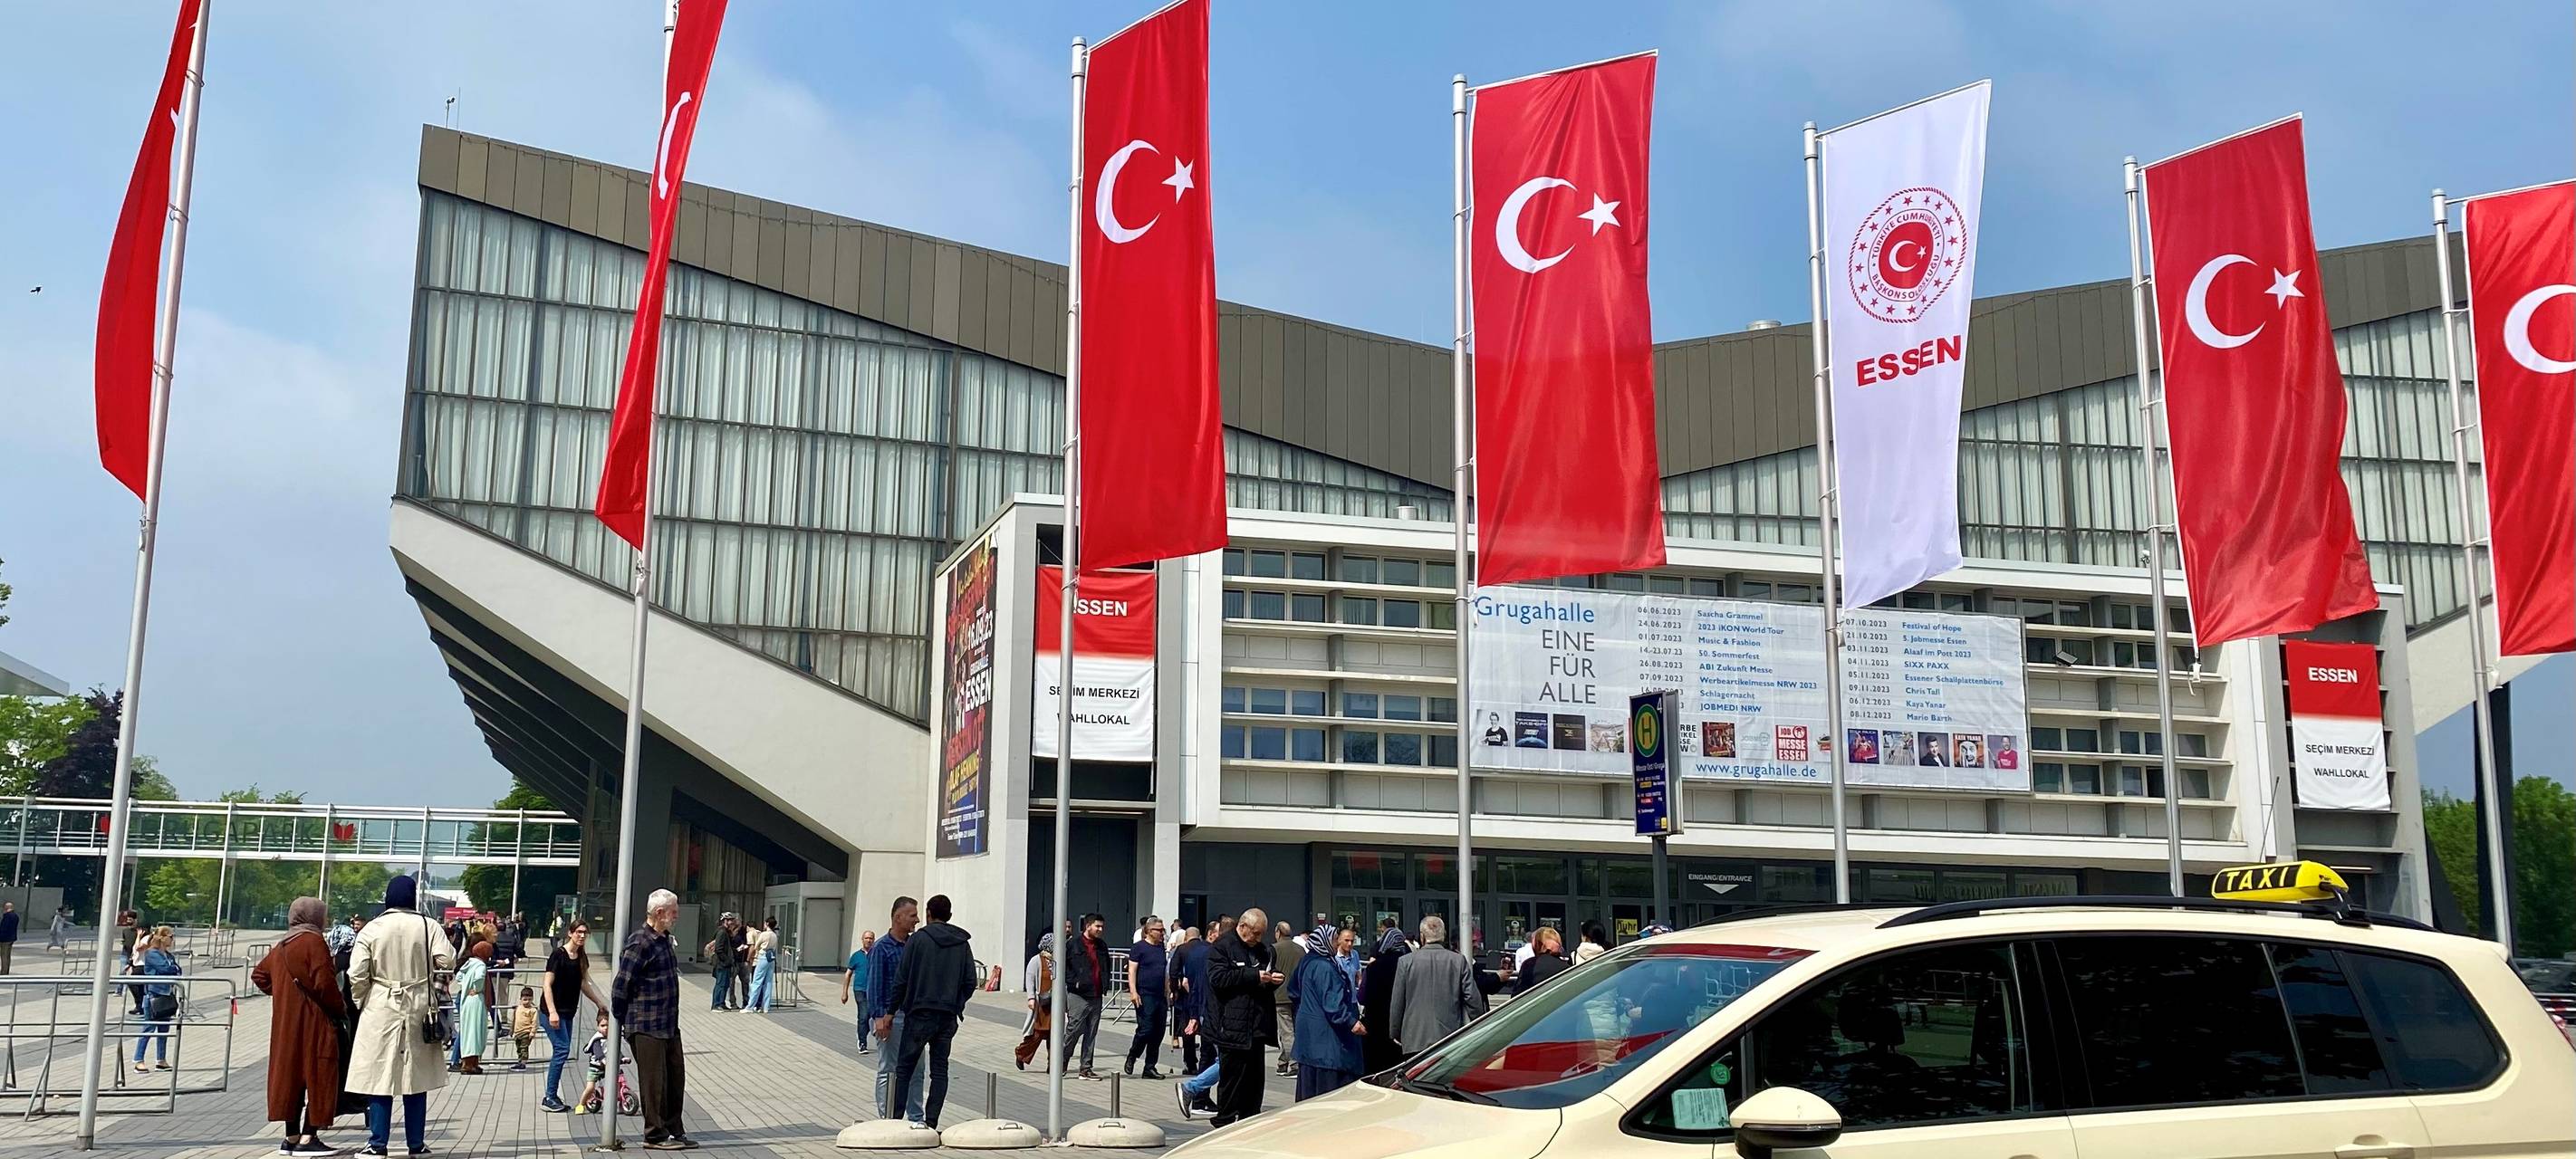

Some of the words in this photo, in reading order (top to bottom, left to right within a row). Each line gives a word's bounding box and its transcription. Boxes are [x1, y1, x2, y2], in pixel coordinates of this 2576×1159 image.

[1857, 334, 1962, 387] ESSEN
[1073, 599, 1128, 617] SSEN
[1475, 596, 1595, 625] Grugahalle
[1638, 607, 1681, 616] 06.06.2023
[1697, 610, 1724, 618] Sascha
[1726, 611, 1764, 620] Grammel
[968, 609, 994, 651] 16.09.23
[1638, 620, 1682, 629] 24.06.2023
[1741, 625, 1766, 634] World
[1767, 627, 1784, 635] Tour
[1845, 618, 1887, 627] 07.10.2023
[1902, 621, 1931, 630] Festival
[1543, 629, 1595, 652] EINE
[1639, 634, 1682, 642] 01.07.2023
[1698, 637, 1721, 645] Music
[1723, 637, 1728, 646] &
[1732, 638, 1761, 647] Fashion
[1847, 632, 1888, 641] 21.10.2023
[1911, 636, 1946, 645] Jobmesse
[1698, 649, 1710, 657] 50.
[1712, 650, 1760, 660] Sommerfest
[1847, 645, 1889, 654] 03.11.2023
[1955, 650, 1972, 658] 2023
[1550, 653, 1596, 678] FÜR
[1639, 660, 1683, 669] 26.08.2023
[1699, 663, 1715, 671] ABI
[1716, 664, 1748, 673] Zukunft
[1750, 666, 1773, 674] Messe
[1848, 657, 1889, 666] 04.11.2023
[1927, 662, 1949, 670] PAXX
[1639, 674, 1683, 682] 07.09.2023
[1700, 676, 1774, 687] Werbeartikelmesse
[1777, 680, 1797, 688] NRW
[1849, 671, 1889, 680] 05.11.2023
[1905, 674, 1934, 682] Essener
[2307, 666, 2359, 684] ESSEN
[966, 666, 992, 713] ESSEN
[1049, 685, 1085, 697] SEİM
[1088, 687, 1139, 699] MERKEZİ
[1539, 682, 1597, 704] ALLE
[1700, 690, 1755, 700] Schlagernacht
[1849, 685, 1890, 693] 09.11.2023
[1657, 697, 1663, 714] 4
[1700, 703, 1739, 712] JOBMEDI
[1741, 704, 1762, 713] NRW
[1850, 697, 1890, 706] 06.12.2023
[1906, 700, 1924, 709] Kaya
[1057, 713, 1131, 725] AHLLOKAL
[1850, 711, 1891, 719] 08.12.2023
[1907, 714, 1929, 722] Mario
[1931, 714, 1952, 722] Barth
[1641, 715, 1652, 745] H
[1780, 726, 1792, 736] JOB
[1778, 738, 1806, 750] MESSE
[2305, 743, 2334, 755] SEÇİM
[2335, 745, 2375, 756] MERKEZİ
[1779, 750, 1806, 761] ESSEN
[1696, 762, 1817, 778] www.grugahalle.de
[2313, 767, 2370, 779] WAHLLOKAL
[1687, 873, 1753, 883] EINGANG/ENTRANCE
[2225, 867, 2290, 891] TAXI
